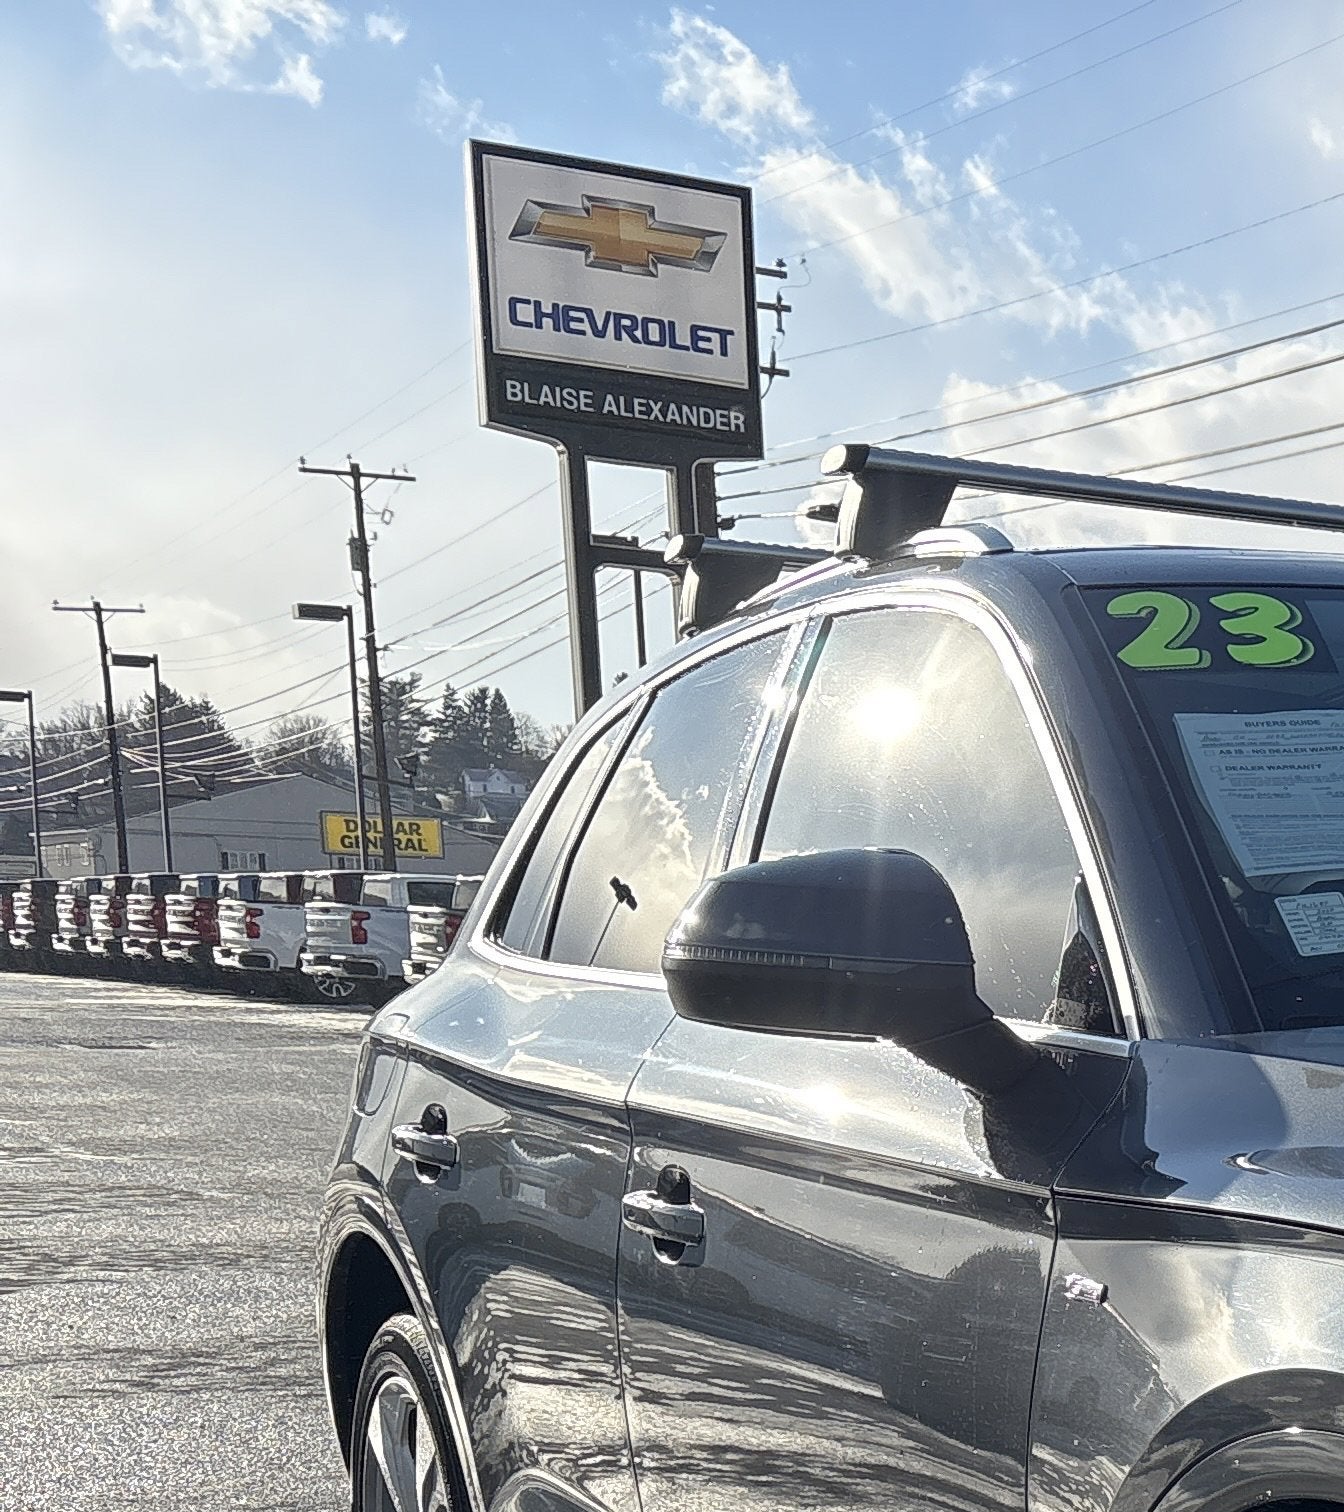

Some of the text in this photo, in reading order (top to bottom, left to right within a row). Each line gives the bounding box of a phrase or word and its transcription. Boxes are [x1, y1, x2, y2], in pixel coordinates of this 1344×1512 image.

[508, 296, 735, 357] CHEVROLET
[505, 379, 746, 433] BLAISE ALEXANDER
[1106, 591, 1315, 671] 23
[1244, 719, 1287, 728] BUYERS
[1289, 718, 1321, 727] GUIDE
[340, 834, 429, 852] GNRAL
[343, 818, 423, 837] DLAR
